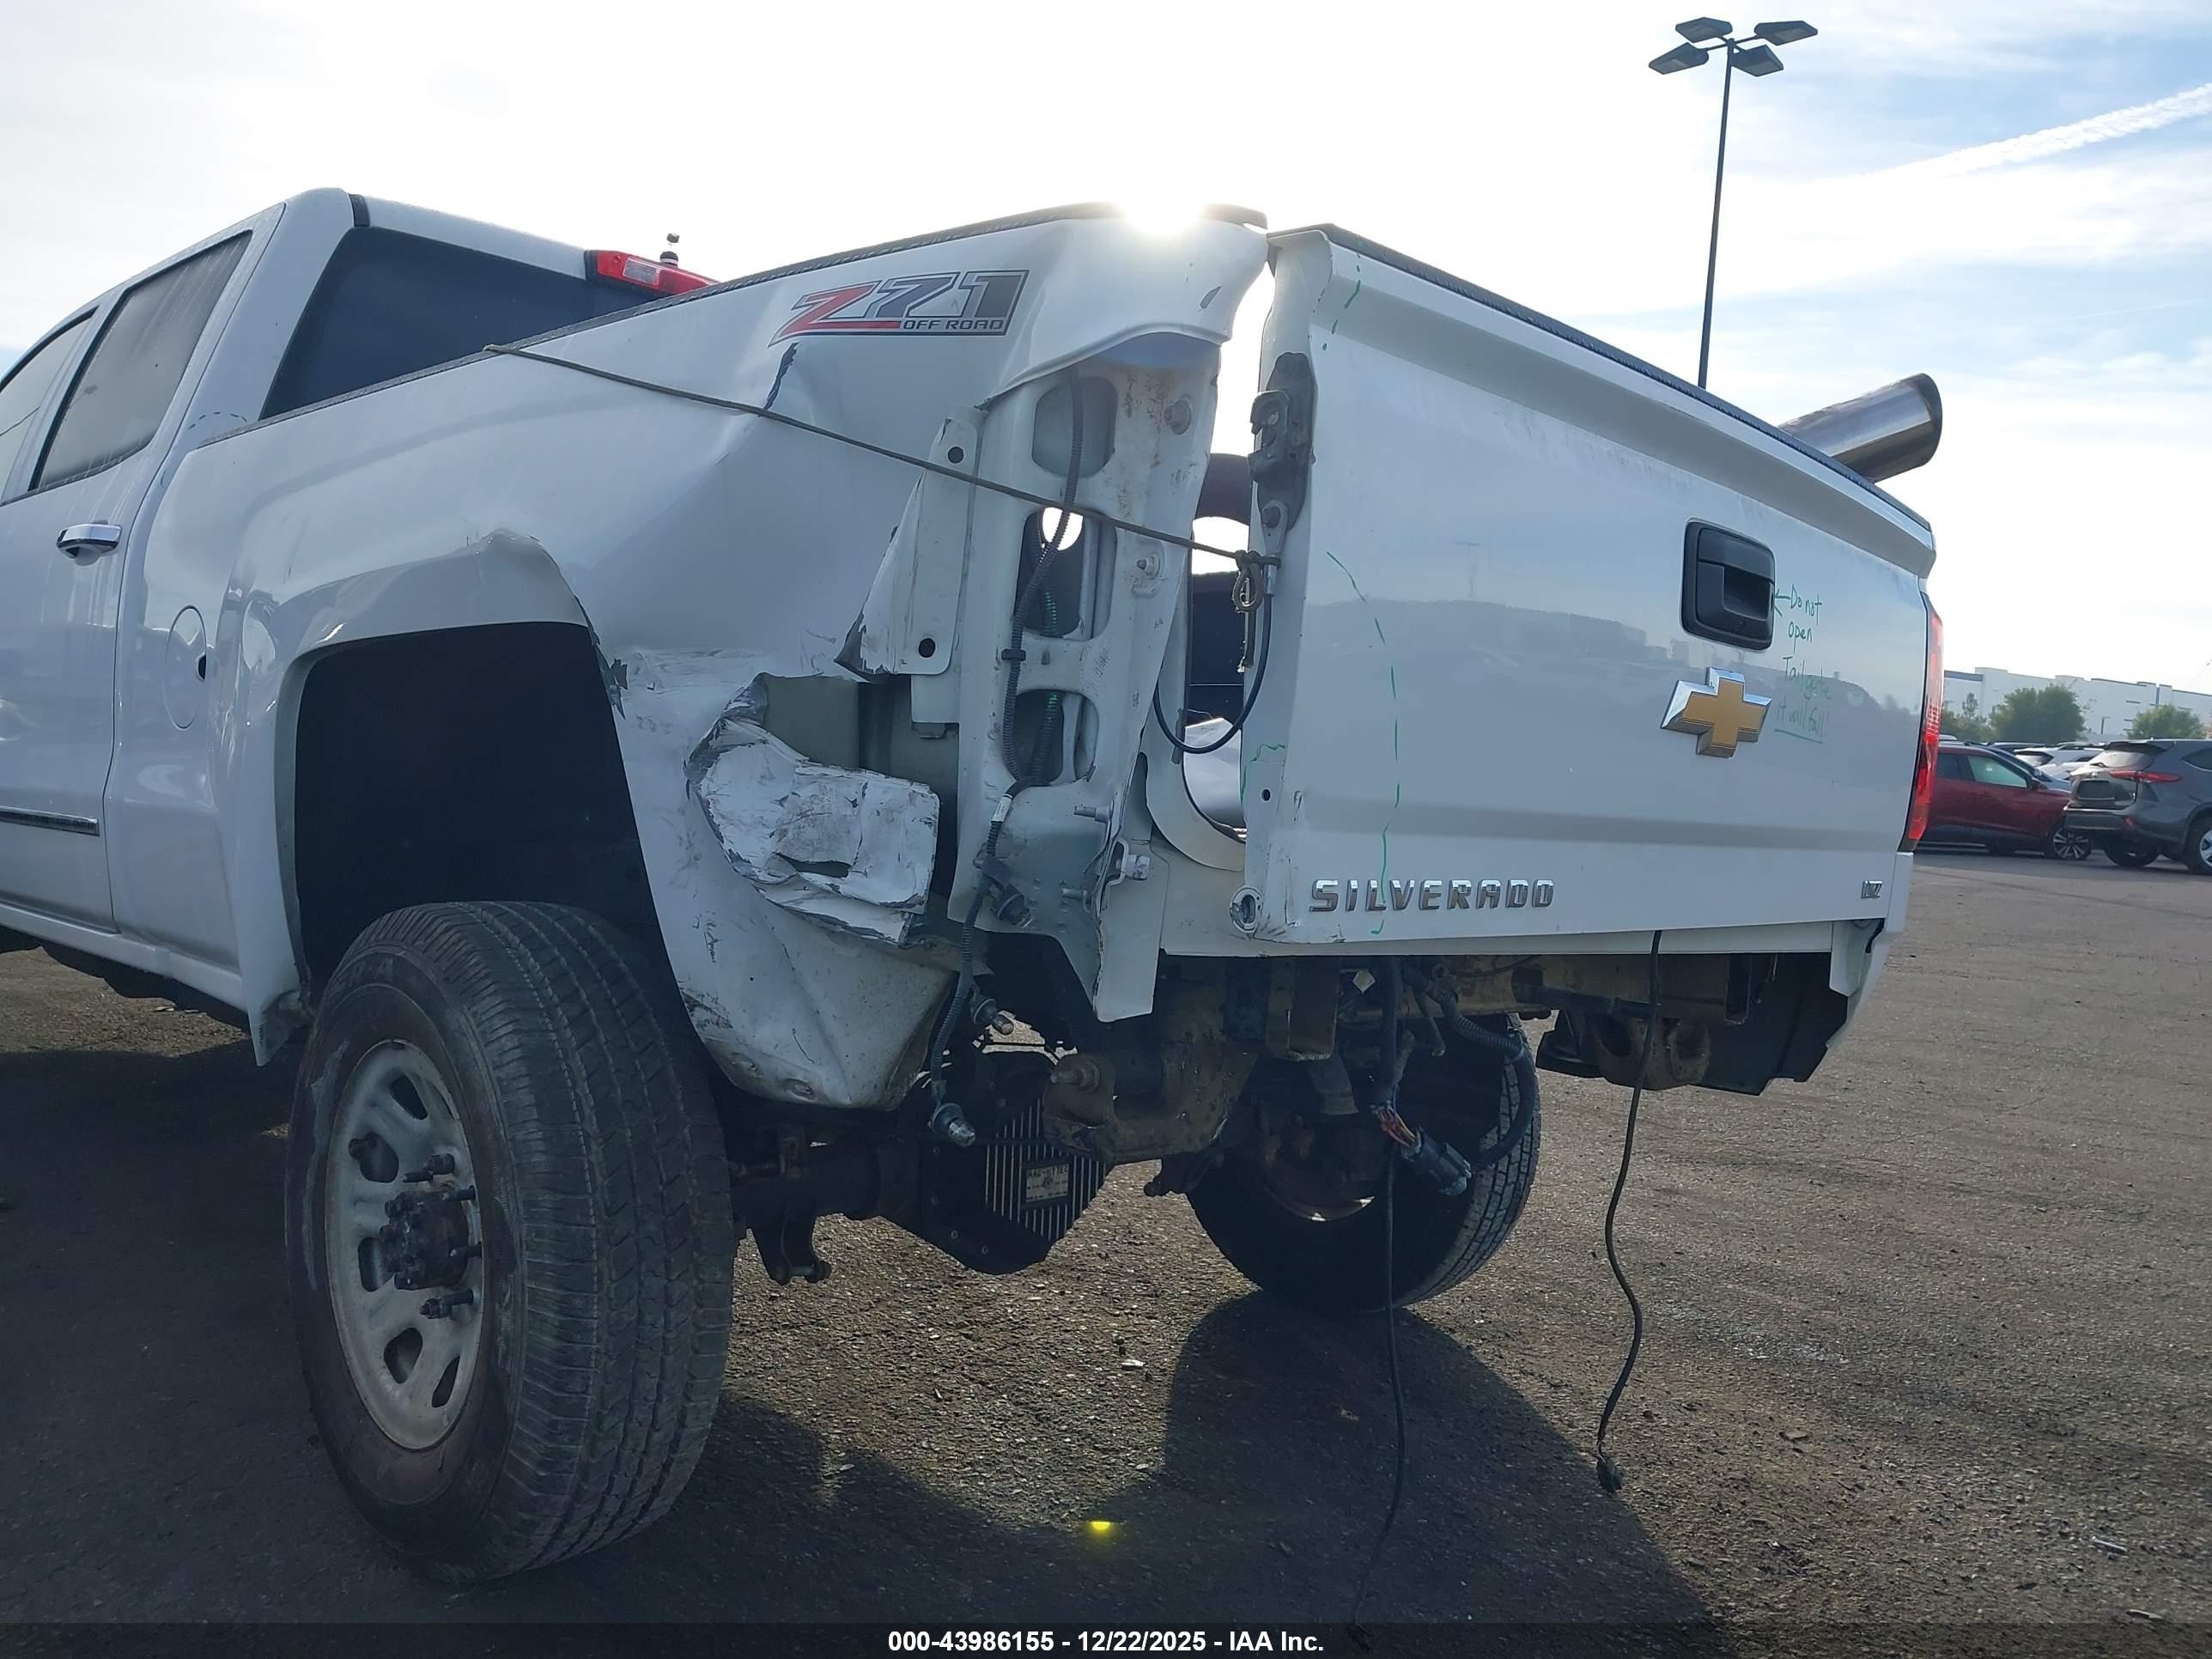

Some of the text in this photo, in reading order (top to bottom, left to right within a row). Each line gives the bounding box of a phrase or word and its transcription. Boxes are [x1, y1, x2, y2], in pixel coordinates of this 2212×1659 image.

[767, 270, 1030, 348] Z71
[902, 319, 1004, 331] OFF ROAD
[1790, 583, 1822, 625] Do not
[1310, 879, 1554, 913] SILVERADO
